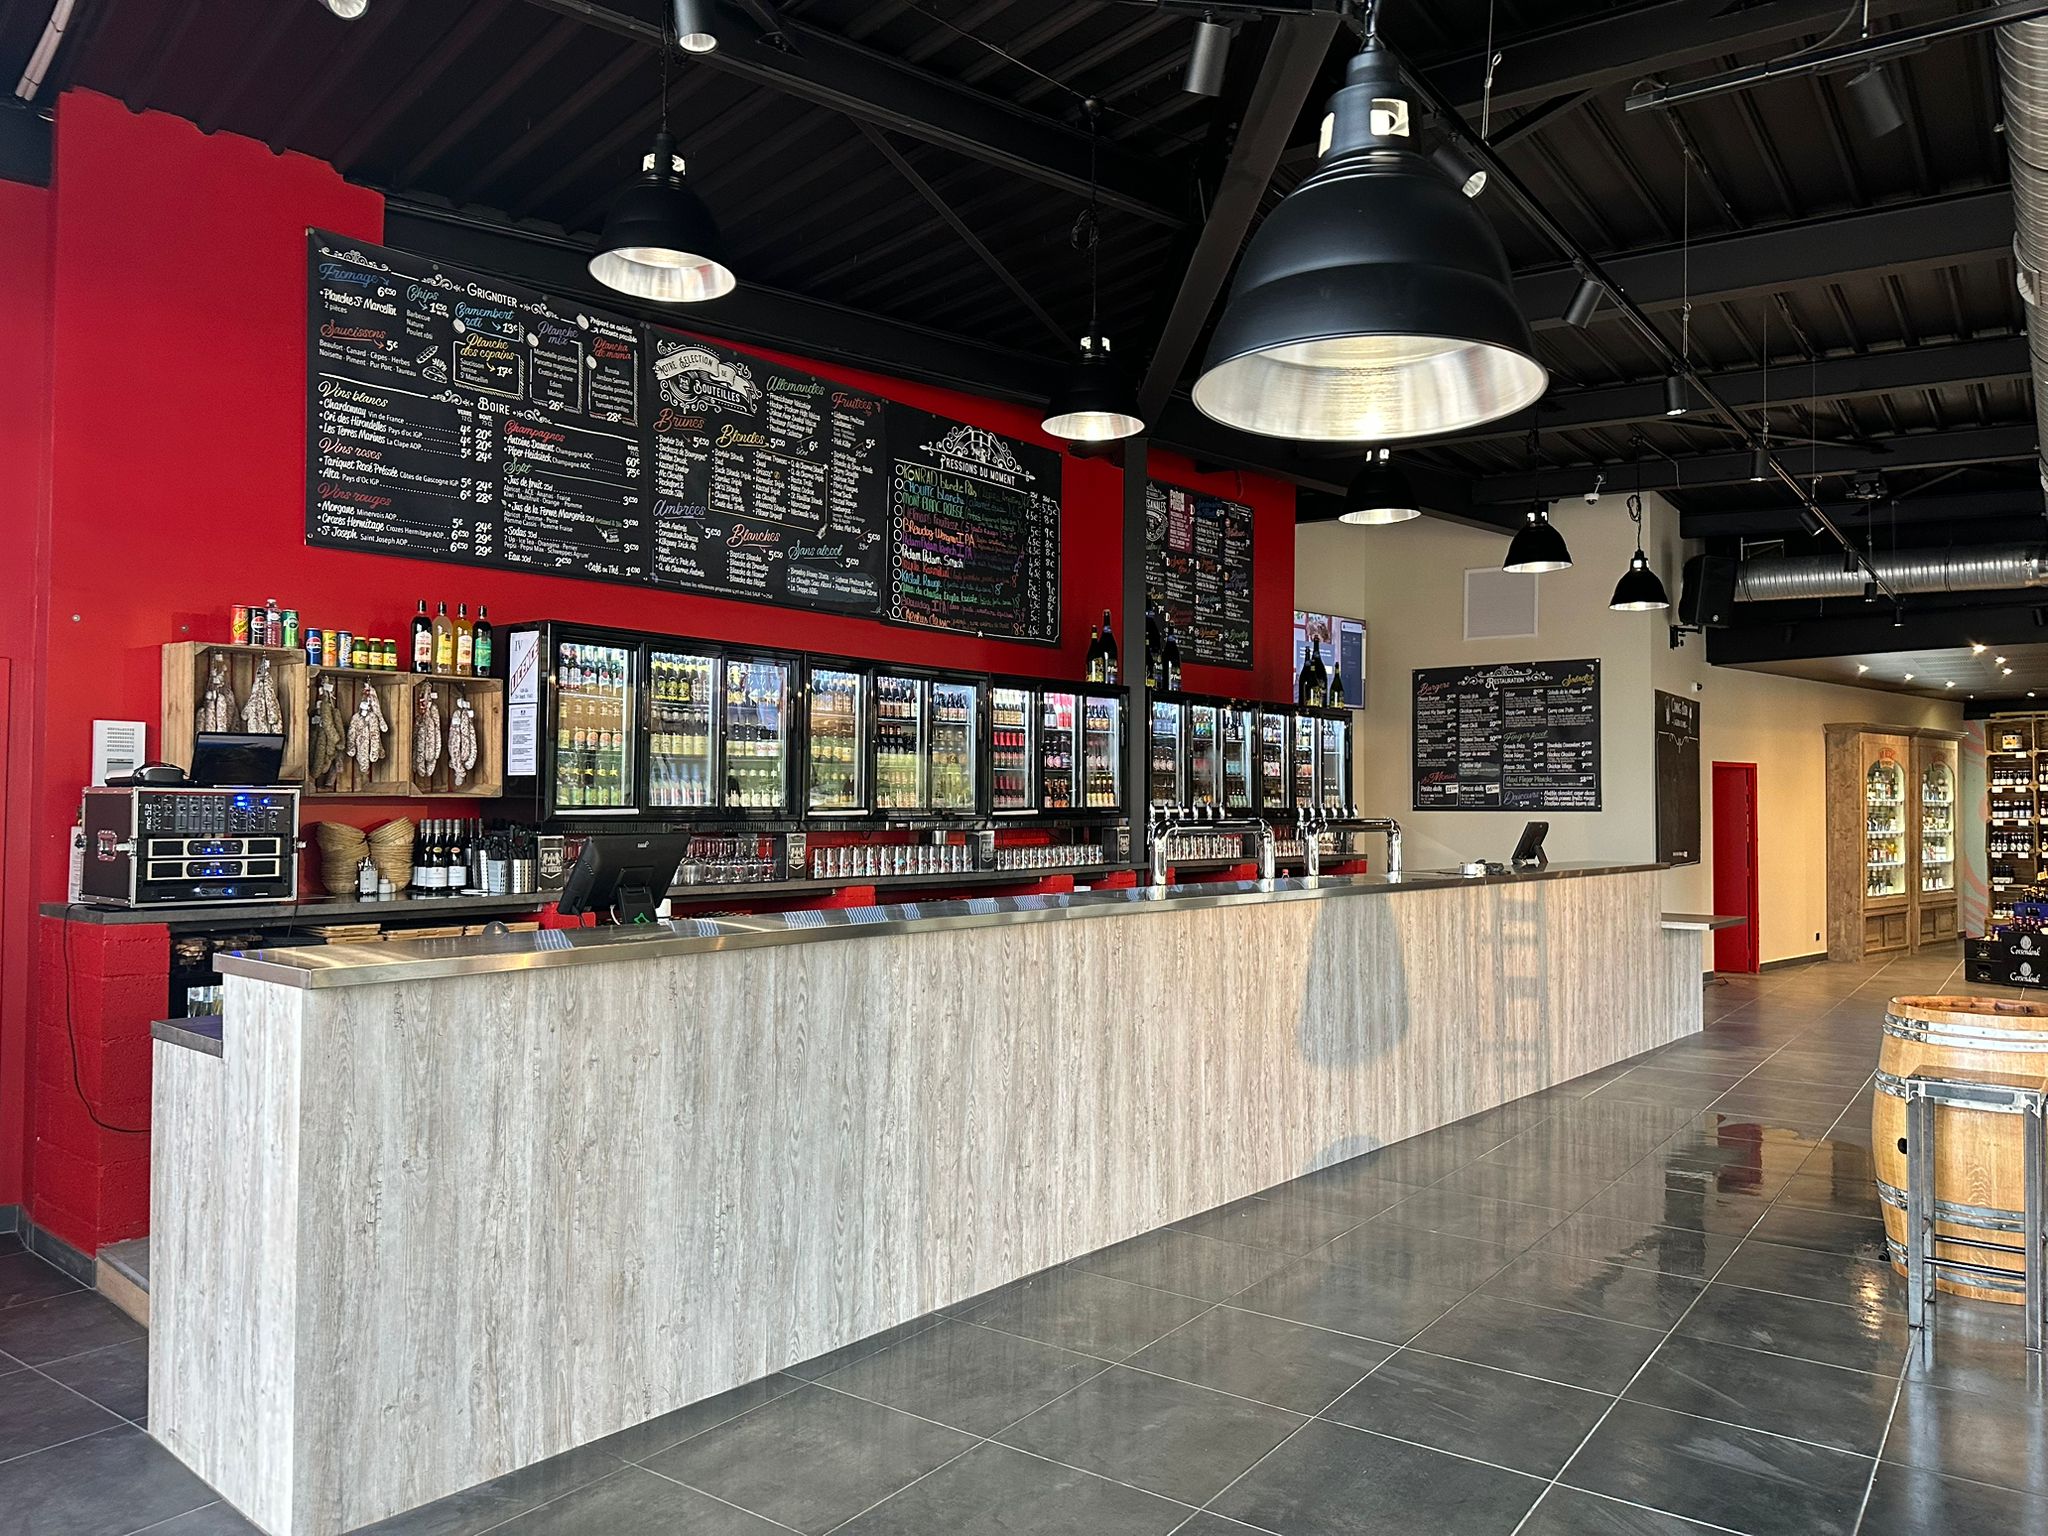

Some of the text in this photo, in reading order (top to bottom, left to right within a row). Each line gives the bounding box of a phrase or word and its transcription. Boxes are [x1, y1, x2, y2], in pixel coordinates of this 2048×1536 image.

[319, 263, 378, 288] Fromage
[407, 284, 439, 302] Chips
[467, 282, 518, 308] GRIGNOTER
[455, 302, 514, 320] Camembert
[320, 320, 386, 338] Saucissons
[406, 318, 425, 329] Nature
[406, 328, 422, 338] Poulet
[538, 321, 579, 338] Planche
[466, 333, 508, 350] Planche
[548, 336, 569, 345] mix
[320, 338, 410, 367] Beaufort Canard Cèpes Herbes
[320, 348, 416, 377] Noisette Piment Pur Porc Taureau
[460, 348, 515, 362] des copains
[318, 380, 388, 407] Vins blancs
[693, 380, 740, 402] BOUTEILLES
[767, 376, 825, 396] Allemandes
[324, 398, 367, 417] Chardonnay
[368, 411, 377, 419] Vin
[387, 415, 404, 424] France
[477, 397, 510, 414] BOIRE
[324, 411, 336, 422] Cri
[337, 414, 350, 424] des
[351, 415, 387, 432] Hirondelles
[388, 426, 400, 436] Pays
[653, 408, 704, 432] Brunes
[323, 422, 336, 434] Les
[337, 426, 357, 438] Terres
[358, 430, 386, 444] Marines
[393, 439, 409, 449] Clape
[410, 442, 422, 450] AOP
[716, 424, 765, 448] Blondes
[319, 437, 353, 456] Vins
[507, 446, 523, 458] Piper
[323, 467, 340, 480] Alta
[342, 473, 355, 484] Pays
[370, 477, 380, 486] IGP
[324, 455, 355, 470] Tariquet
[356, 460, 373, 474] Rosé
[400, 471, 414, 481] Côtes
[423, 476, 448, 487] Gascogne
[940, 454, 1015, 486] PRESSIONS DU MOMENT
[318, 482, 392, 509] Vins rouges
[322, 501, 355, 515] Morgane
[357, 509, 384, 519] Minervois
[540, 506, 557, 518] Ferme
[322, 513, 346, 526] Crozes
[347, 517, 384, 532] Hermitage
[386, 525, 404, 533] Crozes
[405, 527, 432, 539] Hermitage
[432, 531, 444, 539] AOP
[332, 526, 358, 539] Joseph
[360, 533, 374, 542] Saint
[375, 536, 395, 545] Joseph
[396, 538, 408, 546] AOP
[726, 523, 780, 547] Blanches
[788, 539, 814, 560] Sans
[1485, 677, 1525, 690] RESTAURATION
